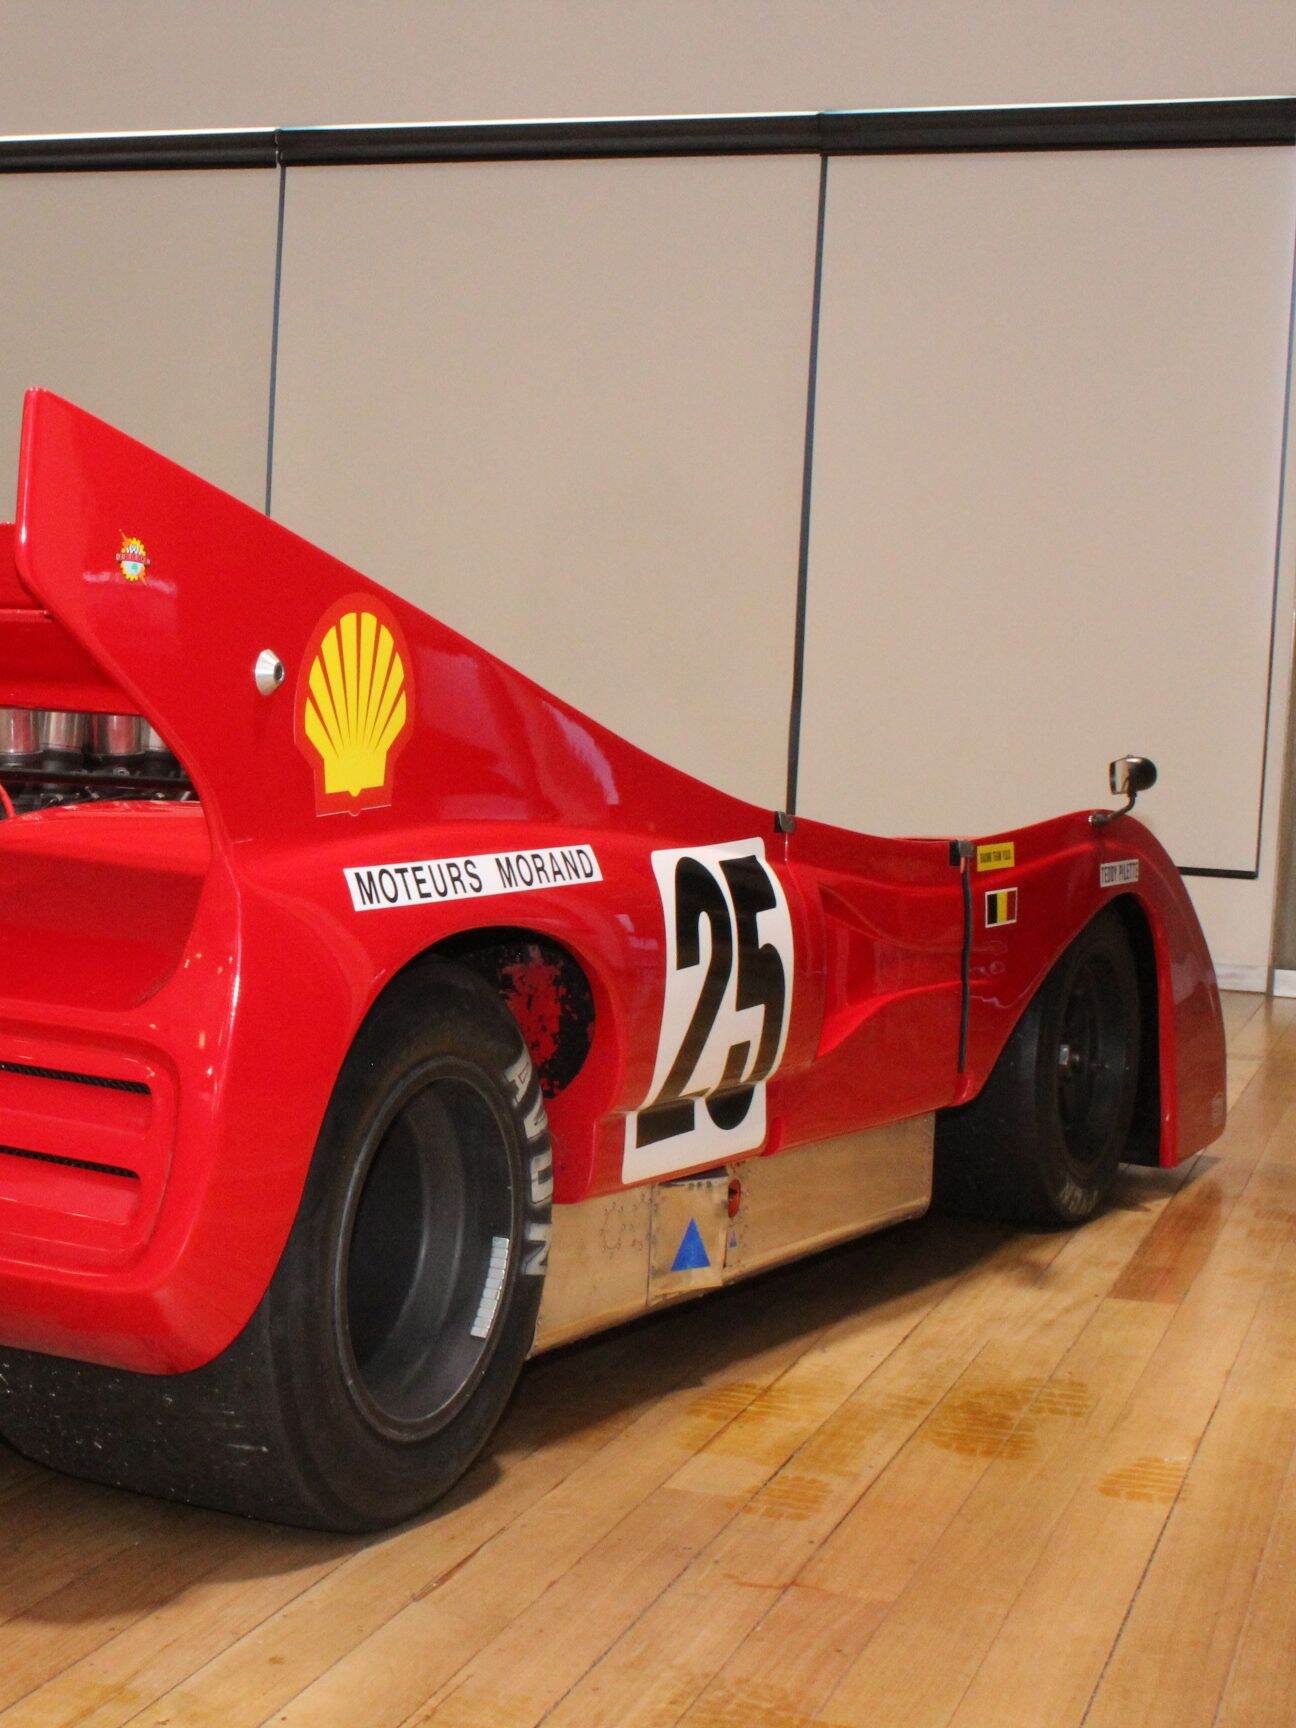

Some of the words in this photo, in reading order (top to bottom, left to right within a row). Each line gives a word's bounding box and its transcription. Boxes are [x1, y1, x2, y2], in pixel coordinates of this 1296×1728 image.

[355, 859, 483, 906] MOTEURS
[495, 849, 594, 889] MORAND
[635, 855, 785, 1149] 25
